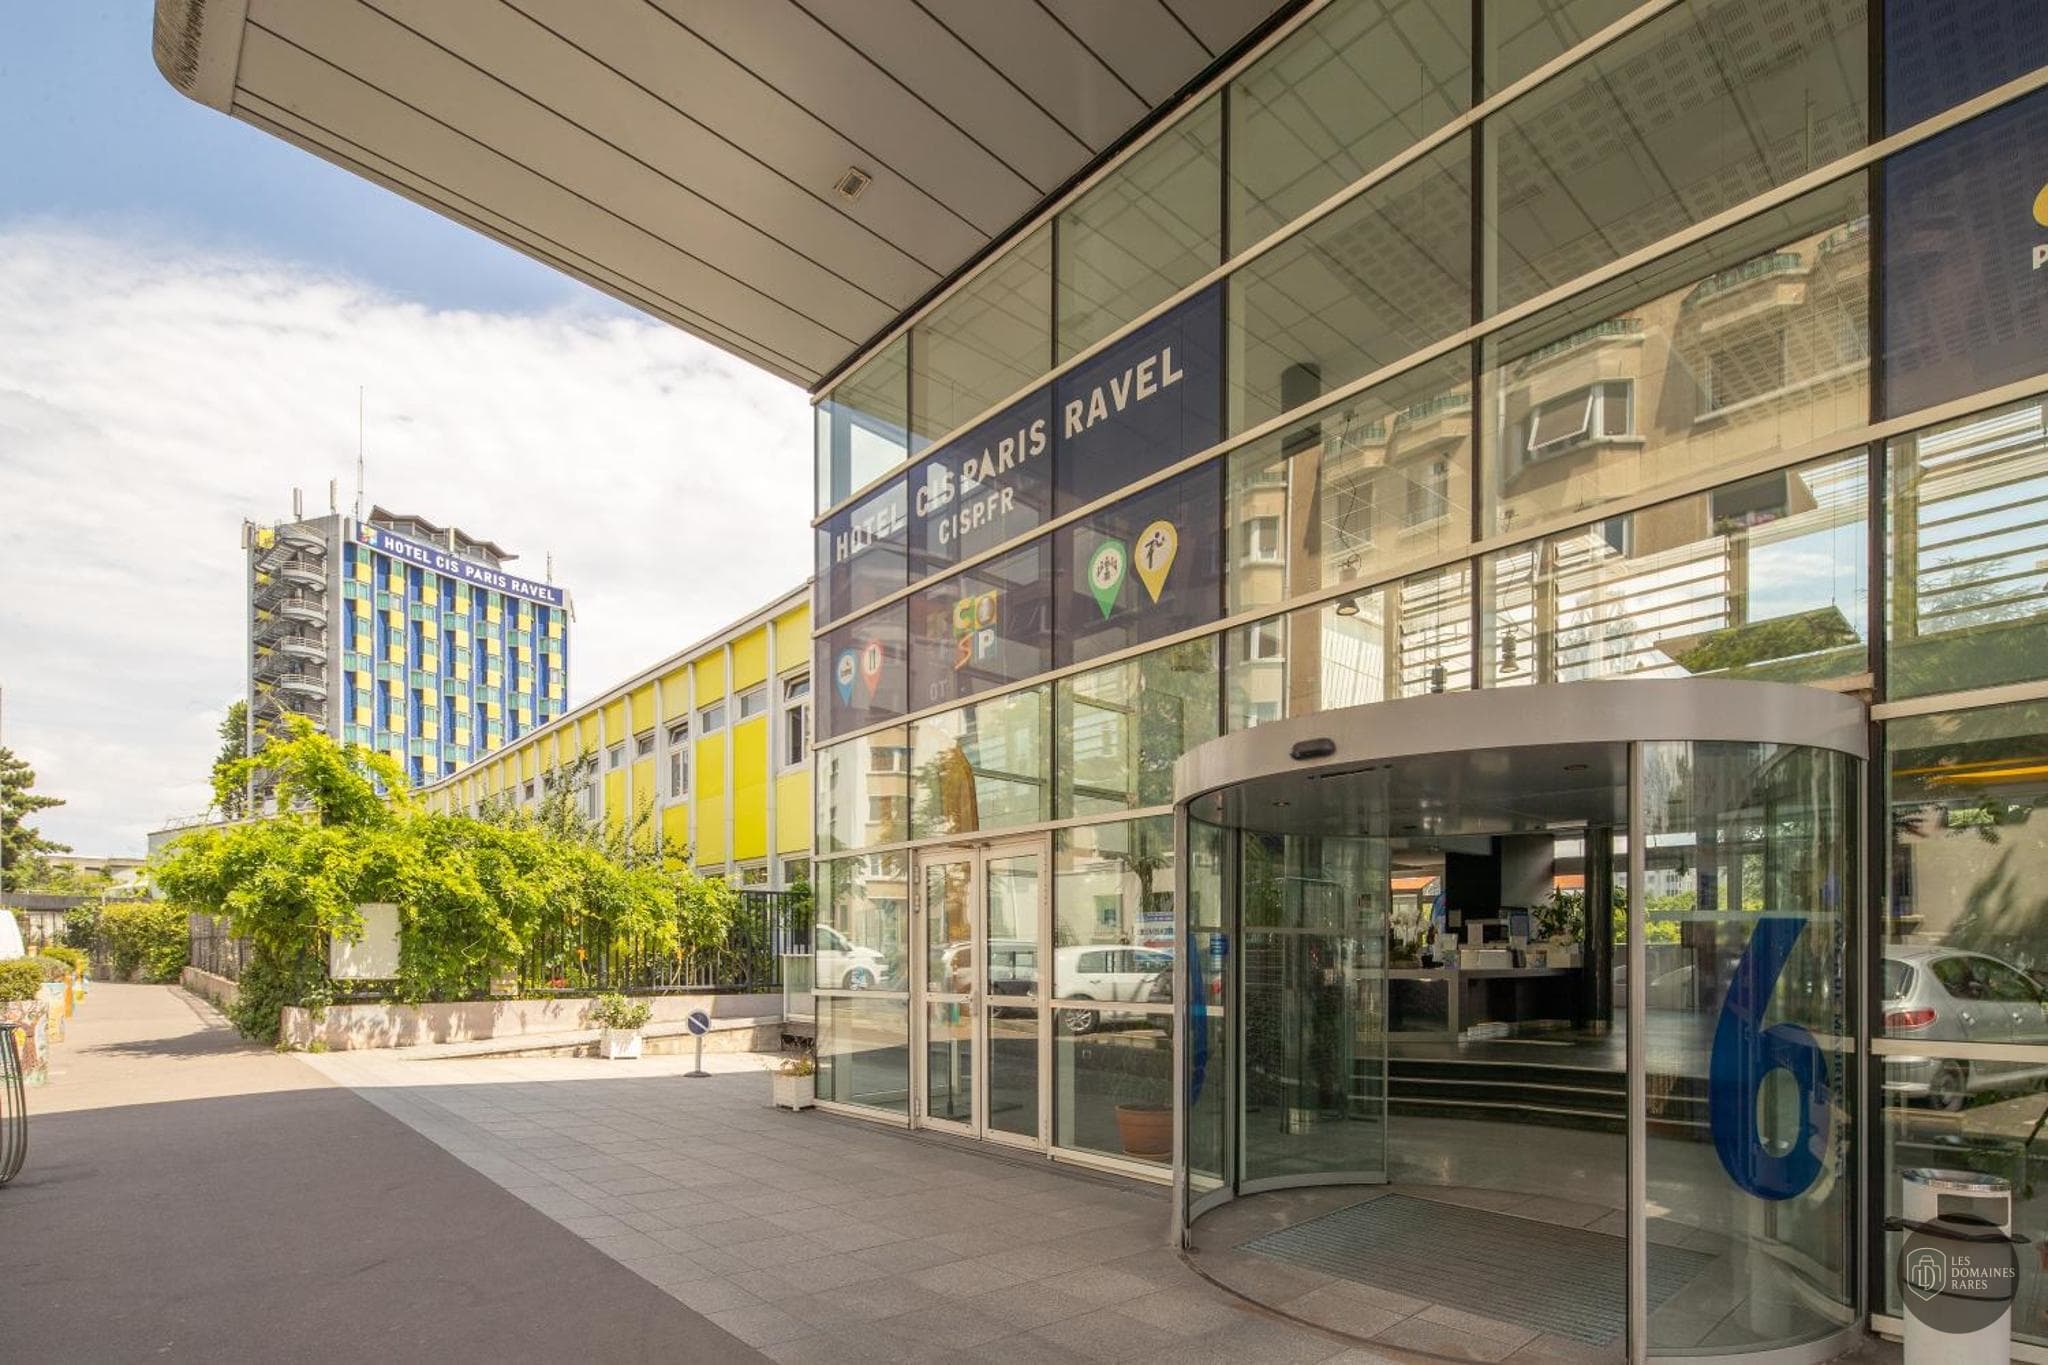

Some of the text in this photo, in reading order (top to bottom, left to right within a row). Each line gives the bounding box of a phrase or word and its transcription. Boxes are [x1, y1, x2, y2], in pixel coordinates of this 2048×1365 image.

[836, 502, 906, 562] HOTEL
[962, 418, 1046, 494] PARIS
[1064, 346, 1183, 440] RAVEL
[938, 486, 1014, 544] CISP.FR
[384, 536, 555, 602] HOTEL CIS PARIS RAVEL
[1708, 918, 1831, 1201] 6
